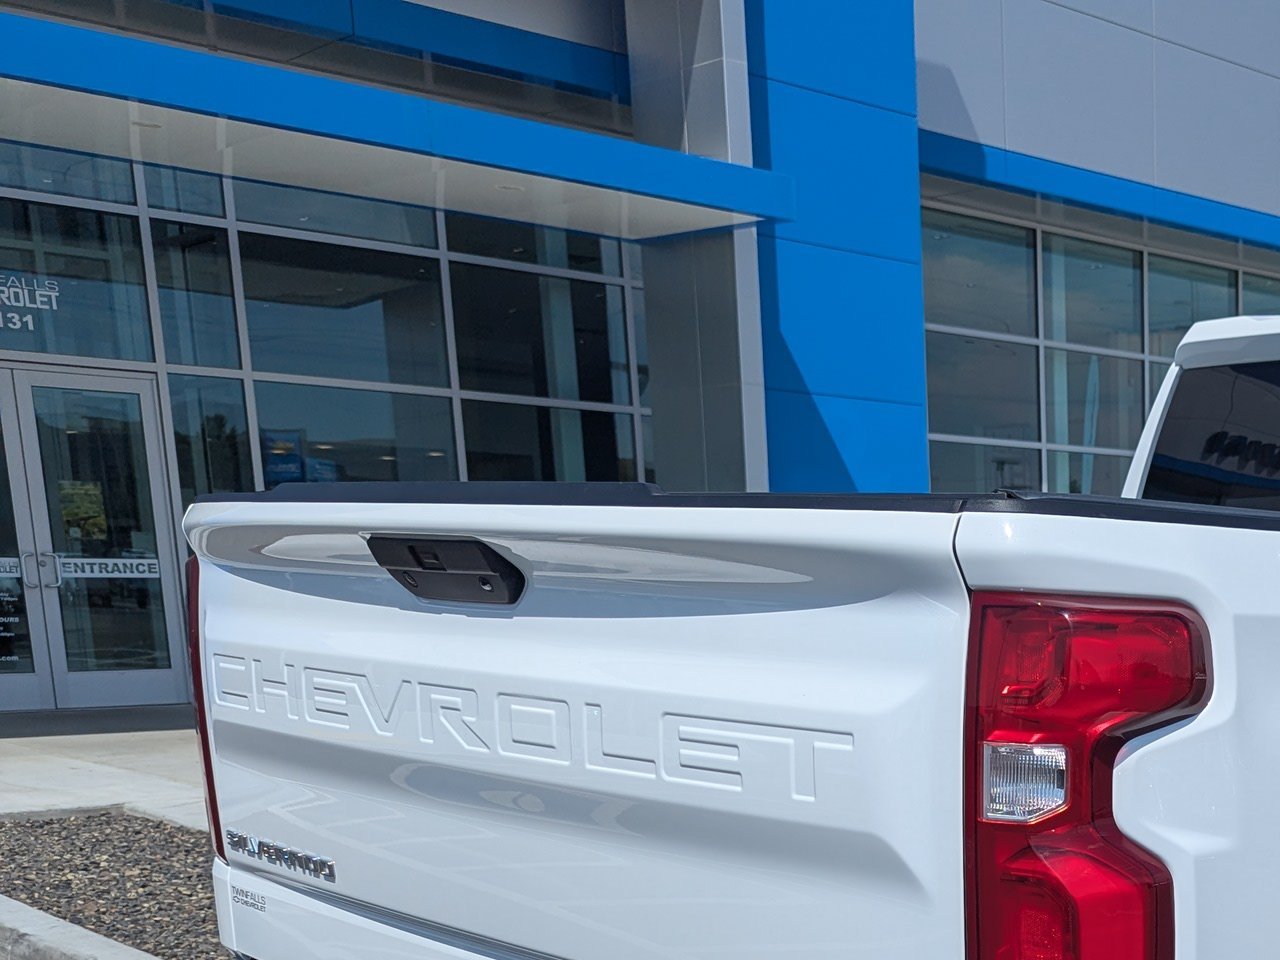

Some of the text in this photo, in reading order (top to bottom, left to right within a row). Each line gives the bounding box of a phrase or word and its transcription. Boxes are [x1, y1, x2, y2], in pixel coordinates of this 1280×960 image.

[62, 562, 158, 574] ENTRANCE
[212, 653, 855, 802] CHEVROLET
[225, 829, 336, 883] SILVERADO
[240, 898, 266, 913] CHEVROLET
